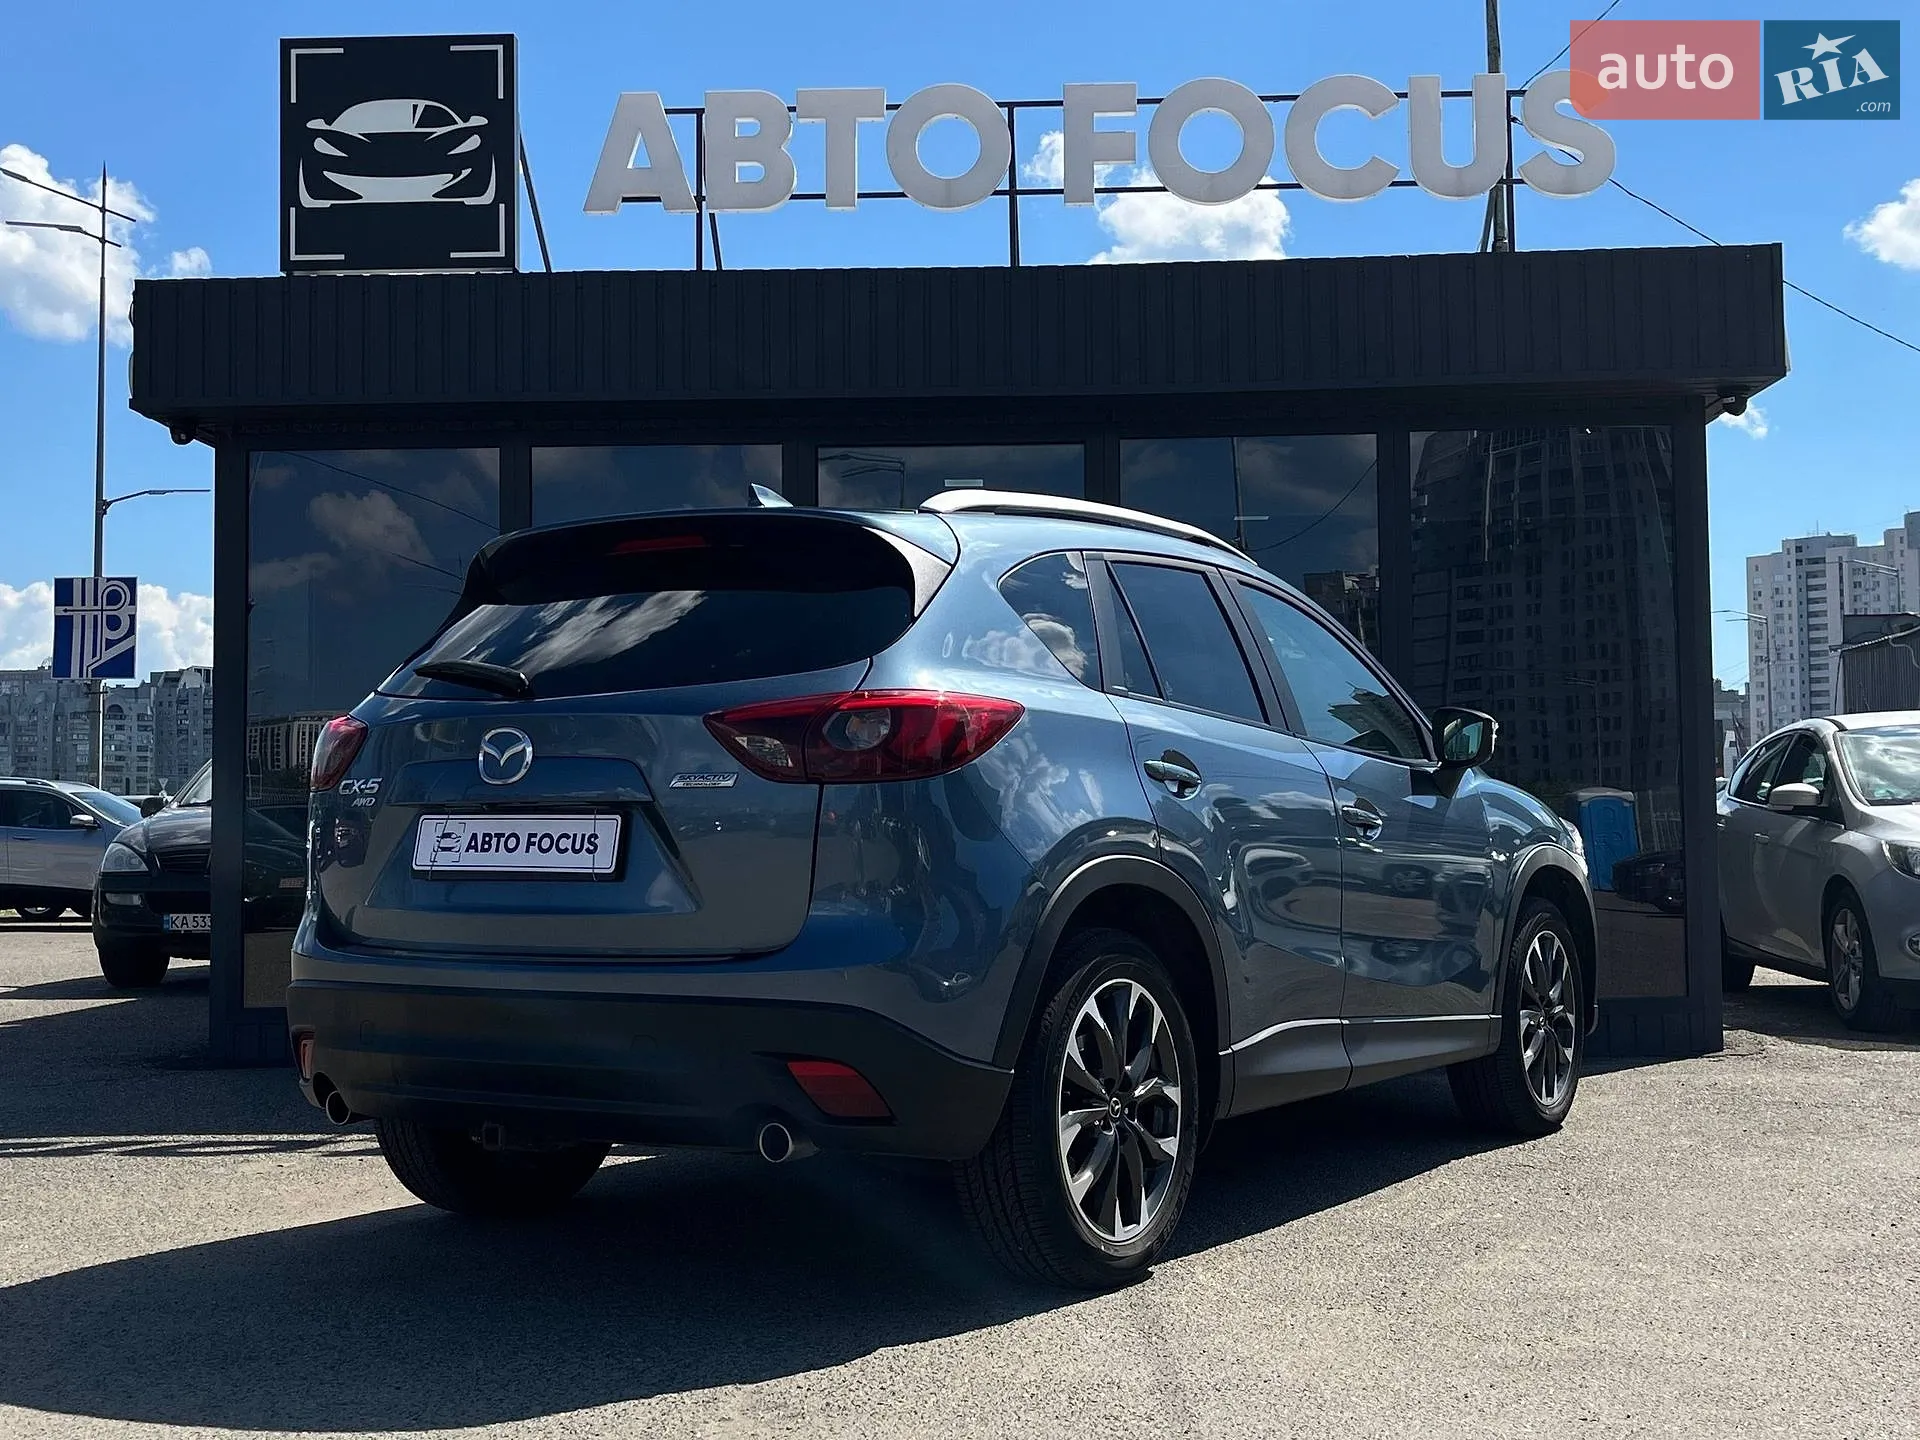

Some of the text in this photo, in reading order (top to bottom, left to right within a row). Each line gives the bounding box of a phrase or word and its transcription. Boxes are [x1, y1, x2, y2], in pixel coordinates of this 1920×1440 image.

[1062, 70, 1616, 206] FOCUS
[339, 777, 383, 795] CX-5
[351, 797, 376, 807] AWD
[525, 833, 600, 855] FOCUS
